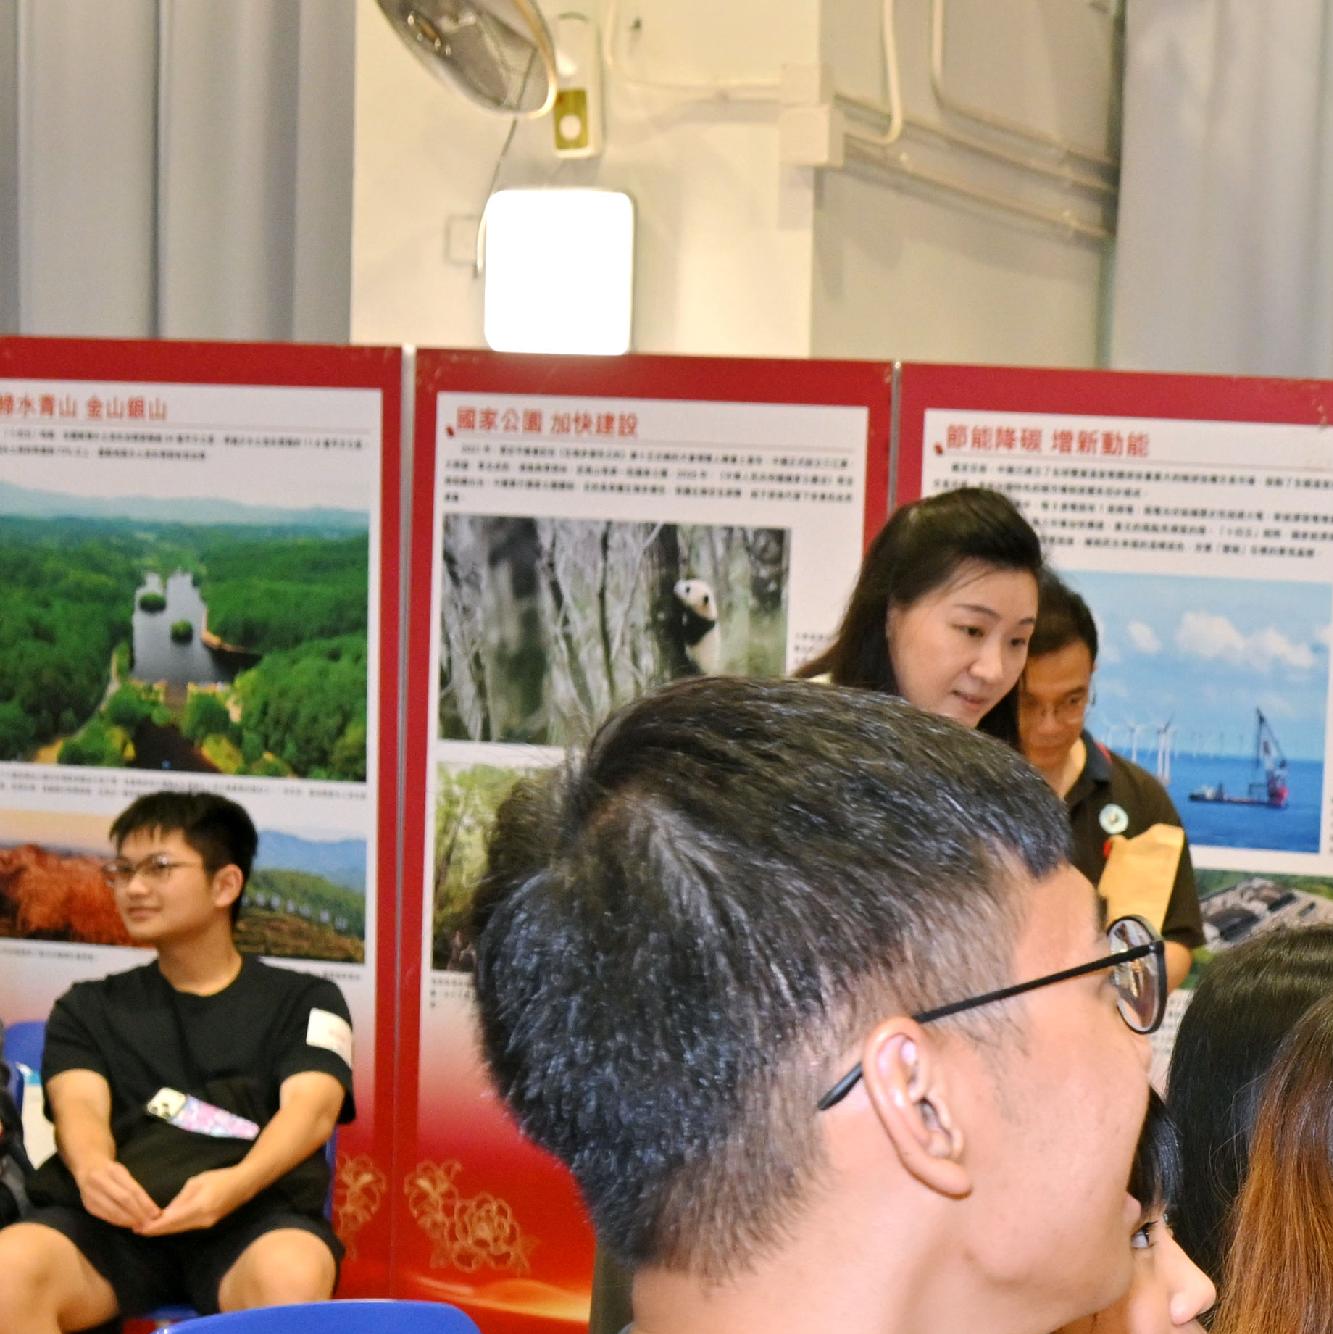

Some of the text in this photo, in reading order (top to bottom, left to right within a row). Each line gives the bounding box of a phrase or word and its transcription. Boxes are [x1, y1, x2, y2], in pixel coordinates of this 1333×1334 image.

[456, 406, 639, 438] 國家公園 加快建設
[945, 424, 1150, 458] 節能降碳 增新動能
